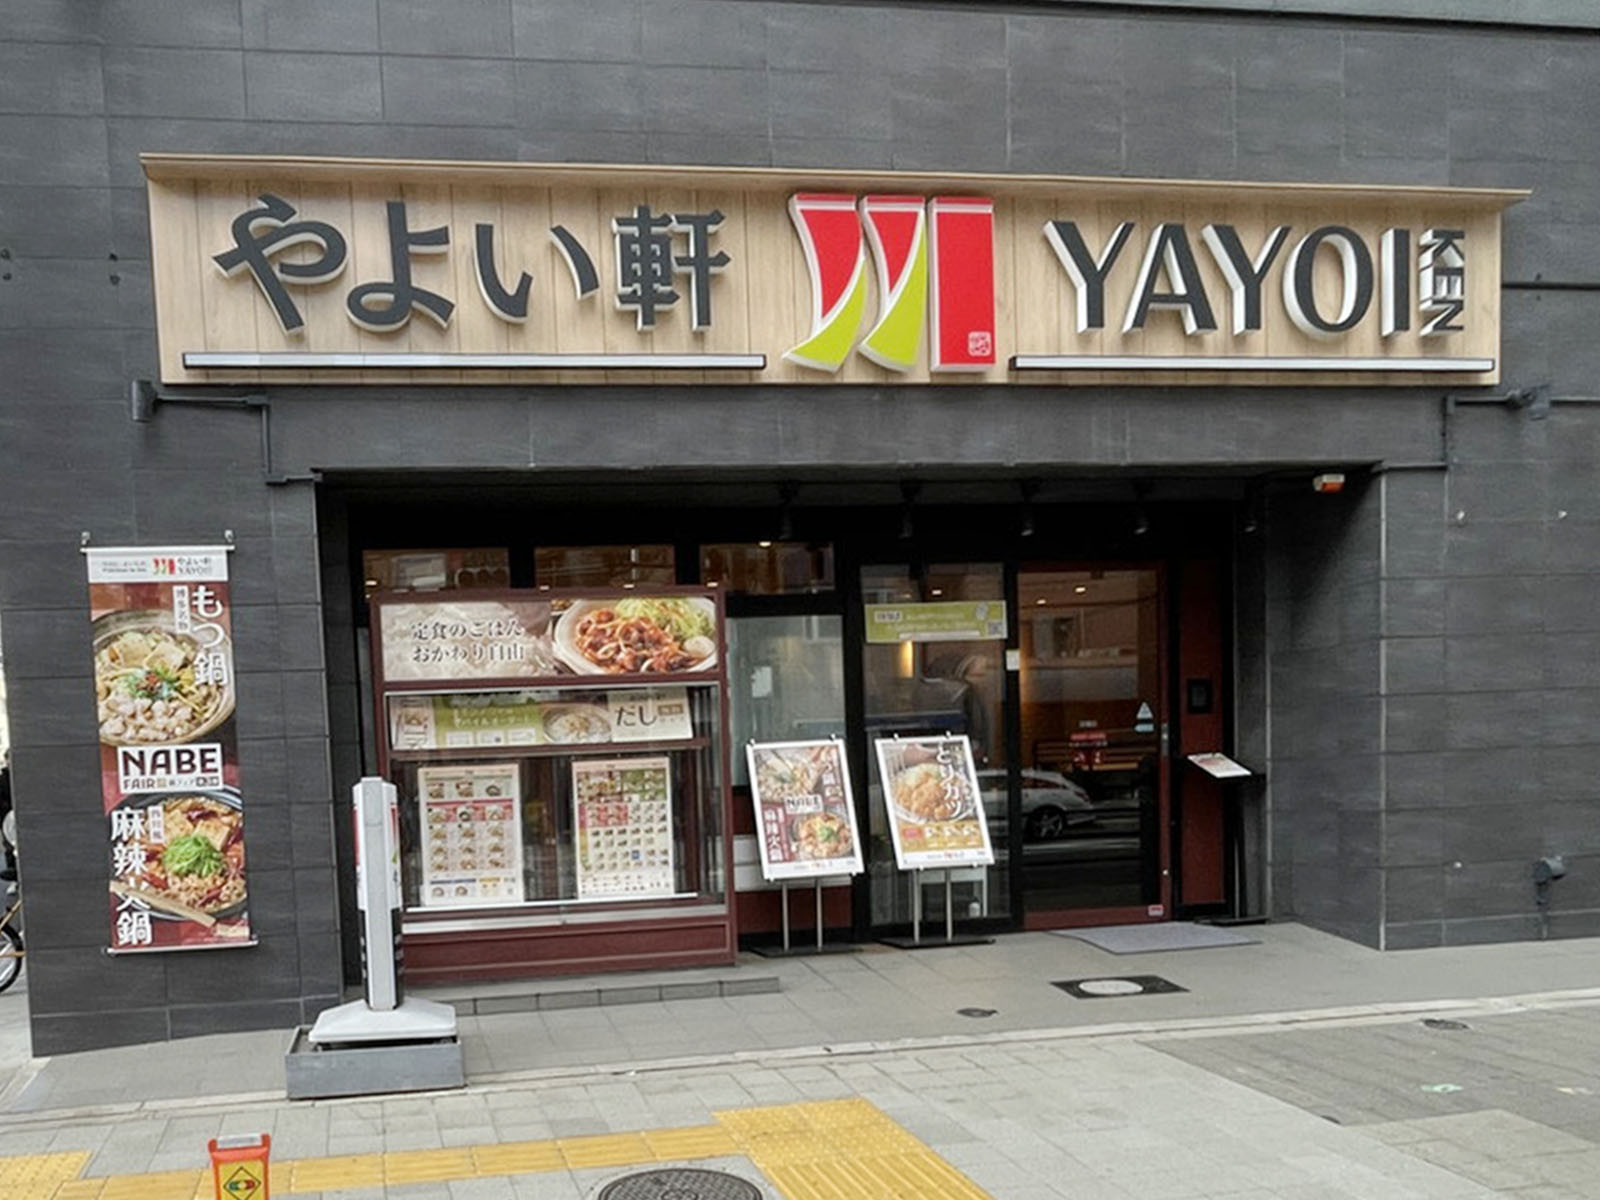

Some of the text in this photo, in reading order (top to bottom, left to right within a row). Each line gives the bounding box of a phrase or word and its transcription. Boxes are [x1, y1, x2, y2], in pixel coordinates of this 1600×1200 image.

[211, 193, 732, 334] やよい軒
[1043, 219, 1411, 336] YAYOI
[1421, 228, 1464, 337] KEN
[191, 584, 227, 685] もつ鍋
[410, 619, 522, 641] 定食のごはん
[411, 641, 524, 662] おかわり自由
[615, 703, 658, 727] だし
[122, 747, 219, 776] NABE
[123, 778, 156, 790] FAIR
[111, 806, 152, 946] 麻辣火鍋
